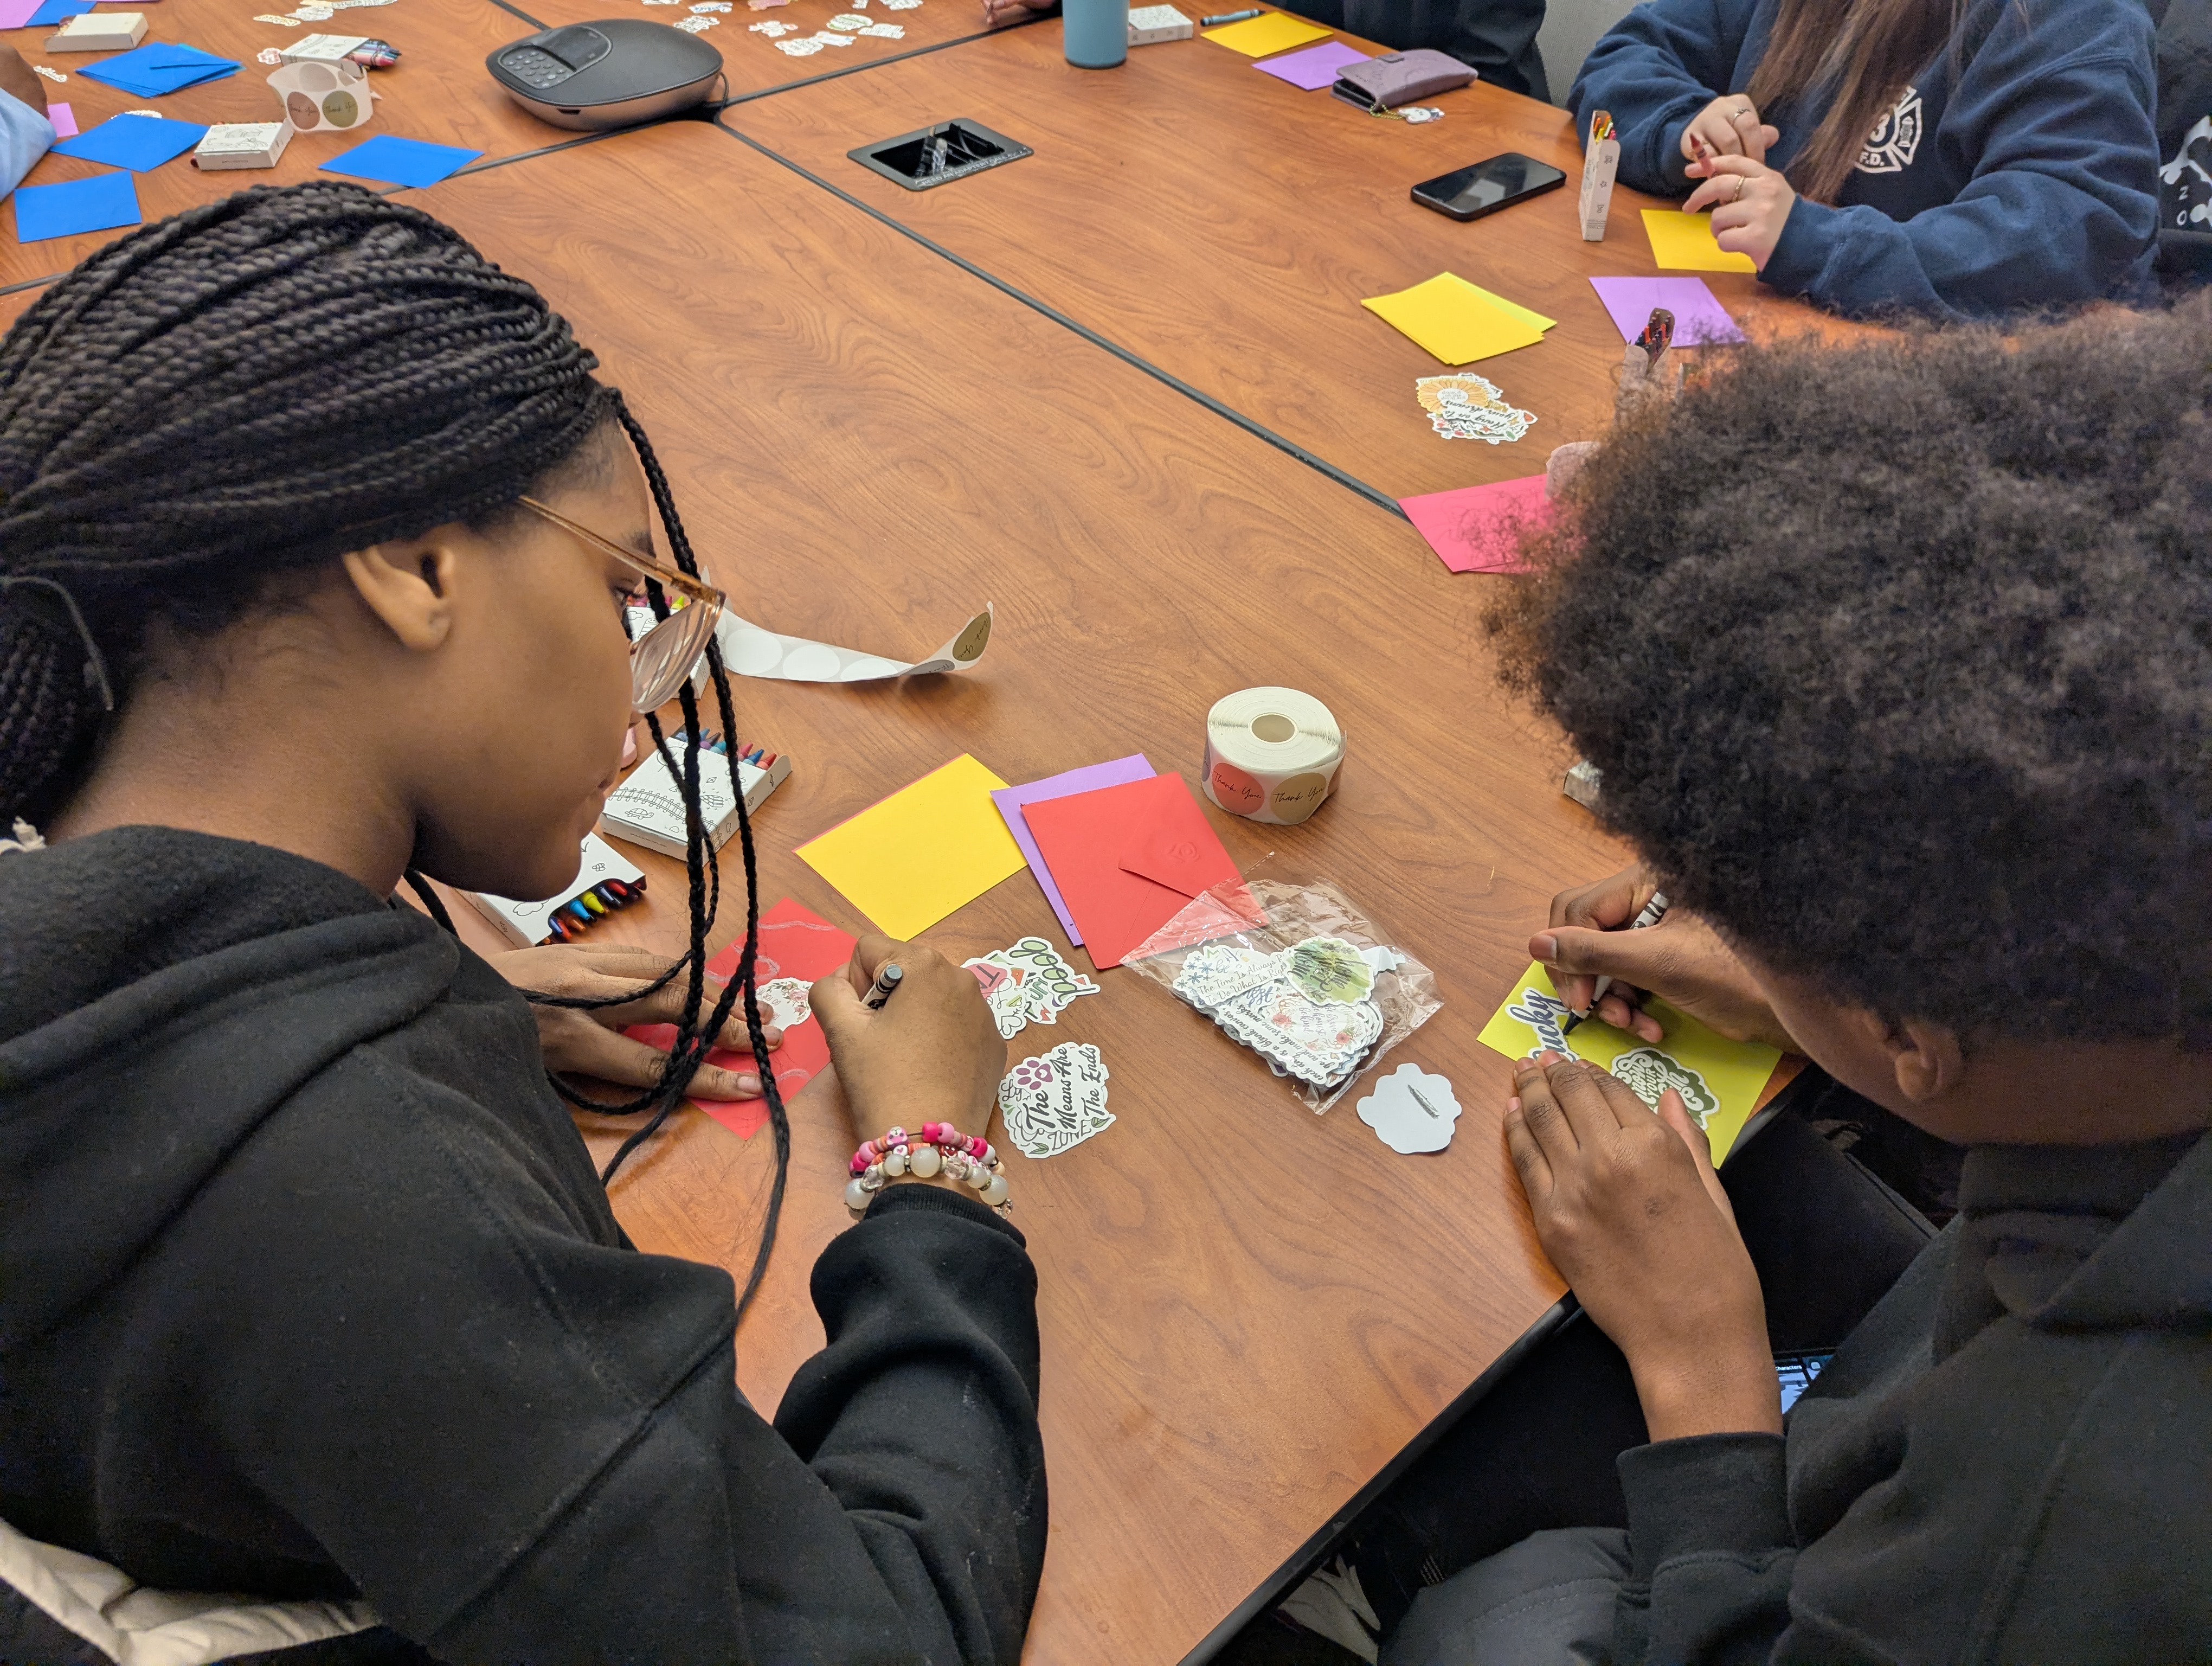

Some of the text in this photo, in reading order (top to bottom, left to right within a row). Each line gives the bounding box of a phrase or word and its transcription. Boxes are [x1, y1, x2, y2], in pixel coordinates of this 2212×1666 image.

[922, 175, 943, 186] NEED
[943, 171, 954, 180] AN
[1444, 410, 1456, 418] to
[1445, 400, 1483, 413] dreams
[1487, 410, 1516, 420] your
[1474, 414, 1507, 430] Hang
[1214, 770, 1262, 800] Thank You
[1272, 786, 1324, 804] Thank You
[1008, 940, 1097, 1003] good
[1197, 960, 1277, 995] The Time Is Always
[1287, 949, 1322, 980] home
[1330, 958, 1372, 989] home
[1205, 994, 1218, 1004] To
[1217, 990, 1231, 999] Do
[1230, 979, 1257, 993] What
[1256, 973, 1268, 982] Is
[1236, 1004, 1335, 1069] go and make some marks
[1300, 1015, 1315, 1034] kind
[1312, 1013, 1327, 1036] honest
[1326, 1014, 1339, 1034] brave
[1244, 1029, 1272, 1048] blank
[1078, 1046, 1105, 1117] The Ends
[1301, 1067, 1324, 1080] each
[1644, 1068, 1660, 1099] YOUR
[1049, 1046, 1077, 1130] Means Are
[1022, 1090, 1056, 1130] The
